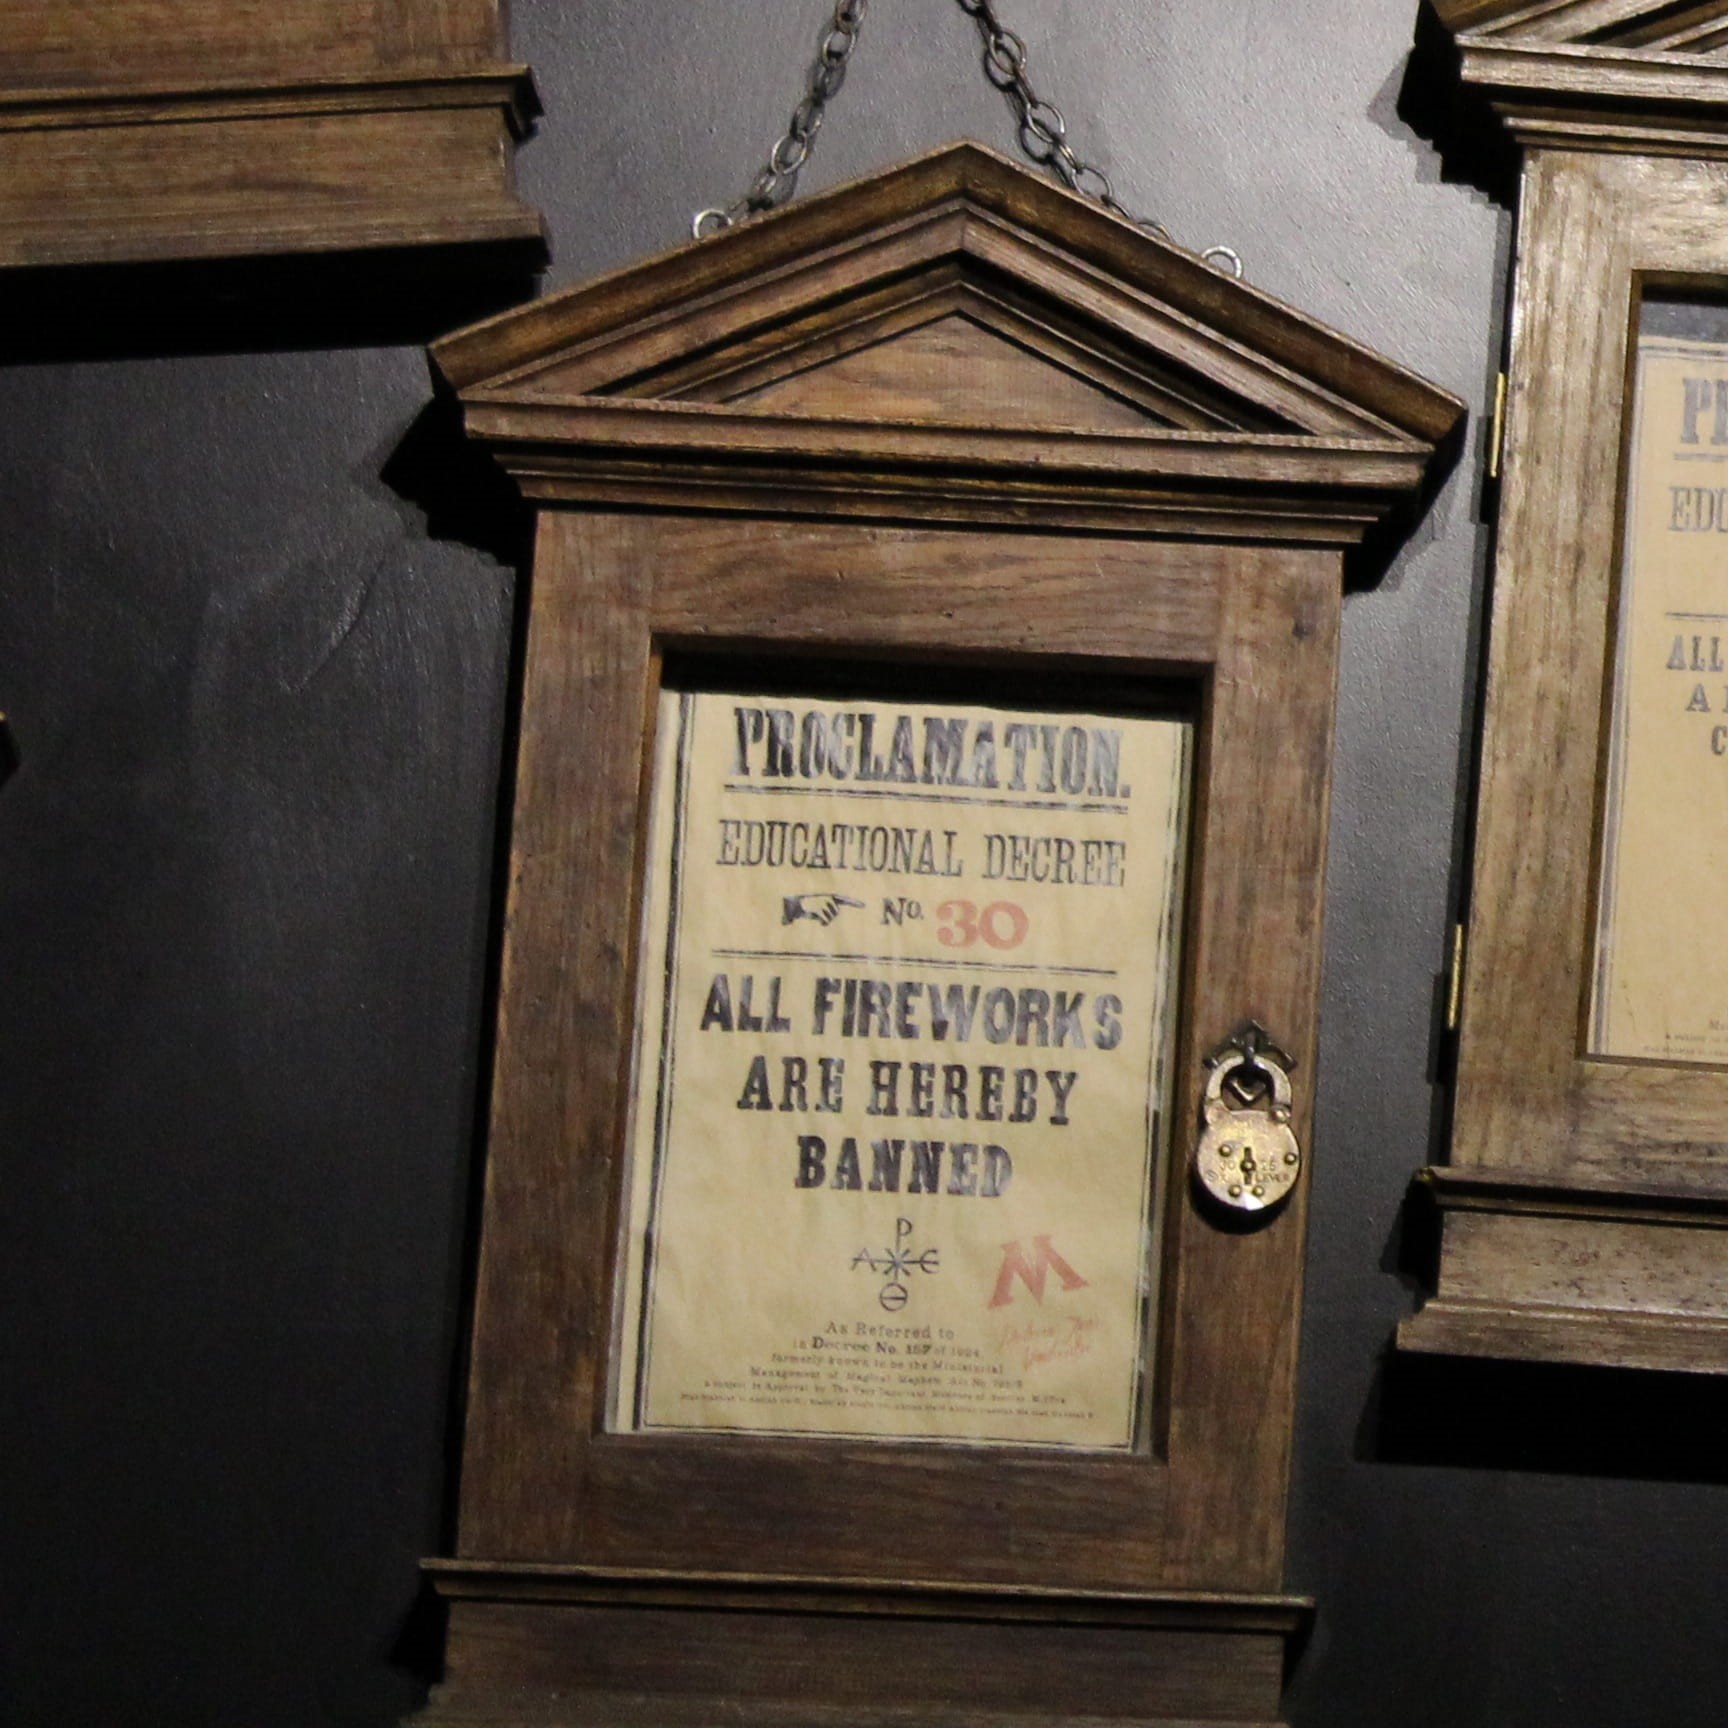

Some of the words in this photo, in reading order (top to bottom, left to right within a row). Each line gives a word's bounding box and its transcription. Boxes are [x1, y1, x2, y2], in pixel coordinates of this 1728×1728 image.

[1665, 635, 1725, 673] ALL
[732, 706, 1132, 798] PROCLAMATION.
[717, 819, 964, 877] EDUCATIONAL
[983, 834, 1127, 887] DECREE
[935, 899, 1029, 950] 30
[700, 974, 791, 1032] ALL
[814, 977, 1124, 1050] FIREWORKS
[737, 1054, 846, 1114] ARE
[866, 1059, 1079, 1126] HEREBY
[794, 1135, 1014, 1198] BANNED
